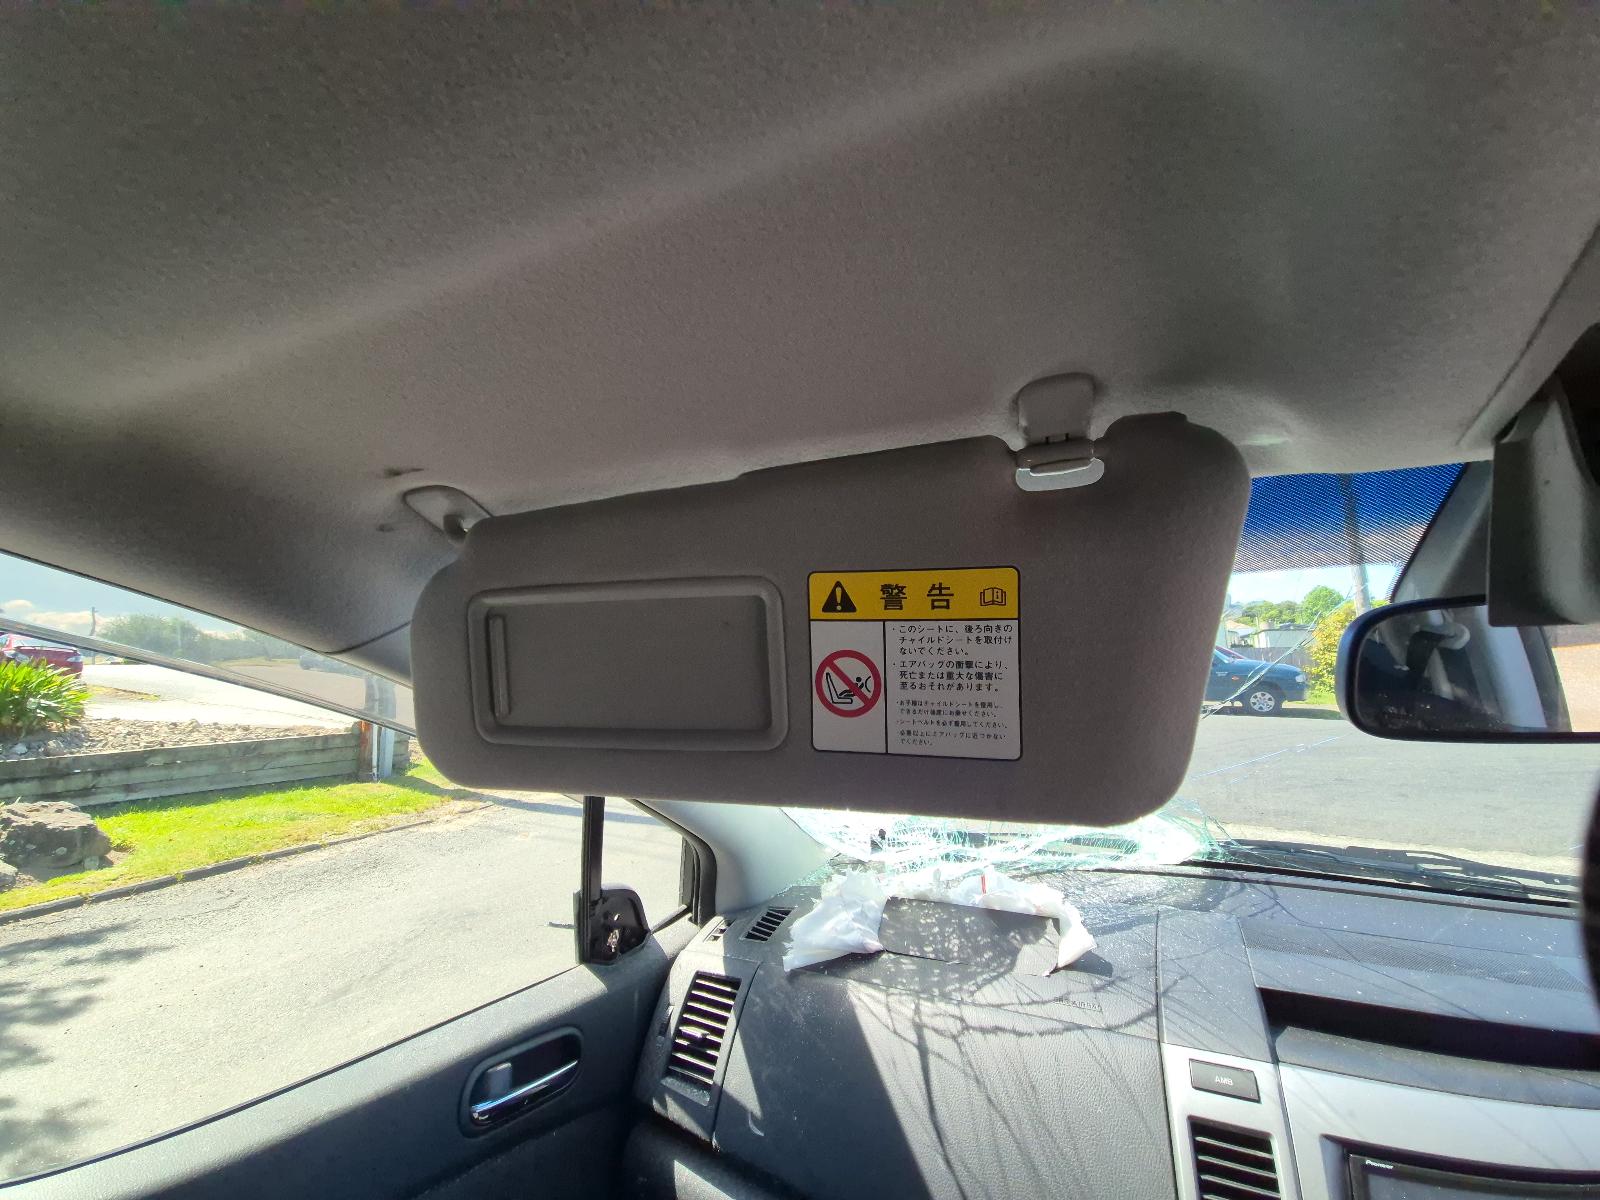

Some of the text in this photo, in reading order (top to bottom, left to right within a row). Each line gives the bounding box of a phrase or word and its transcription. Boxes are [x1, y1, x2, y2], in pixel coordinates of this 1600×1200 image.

[880, 582, 954, 610] 警告
[900, 646, 969, 656] ないでください。
[900, 681, 998, 692] 至るおそれがあります。
[1215, 1075, 1234, 1086] AMB
